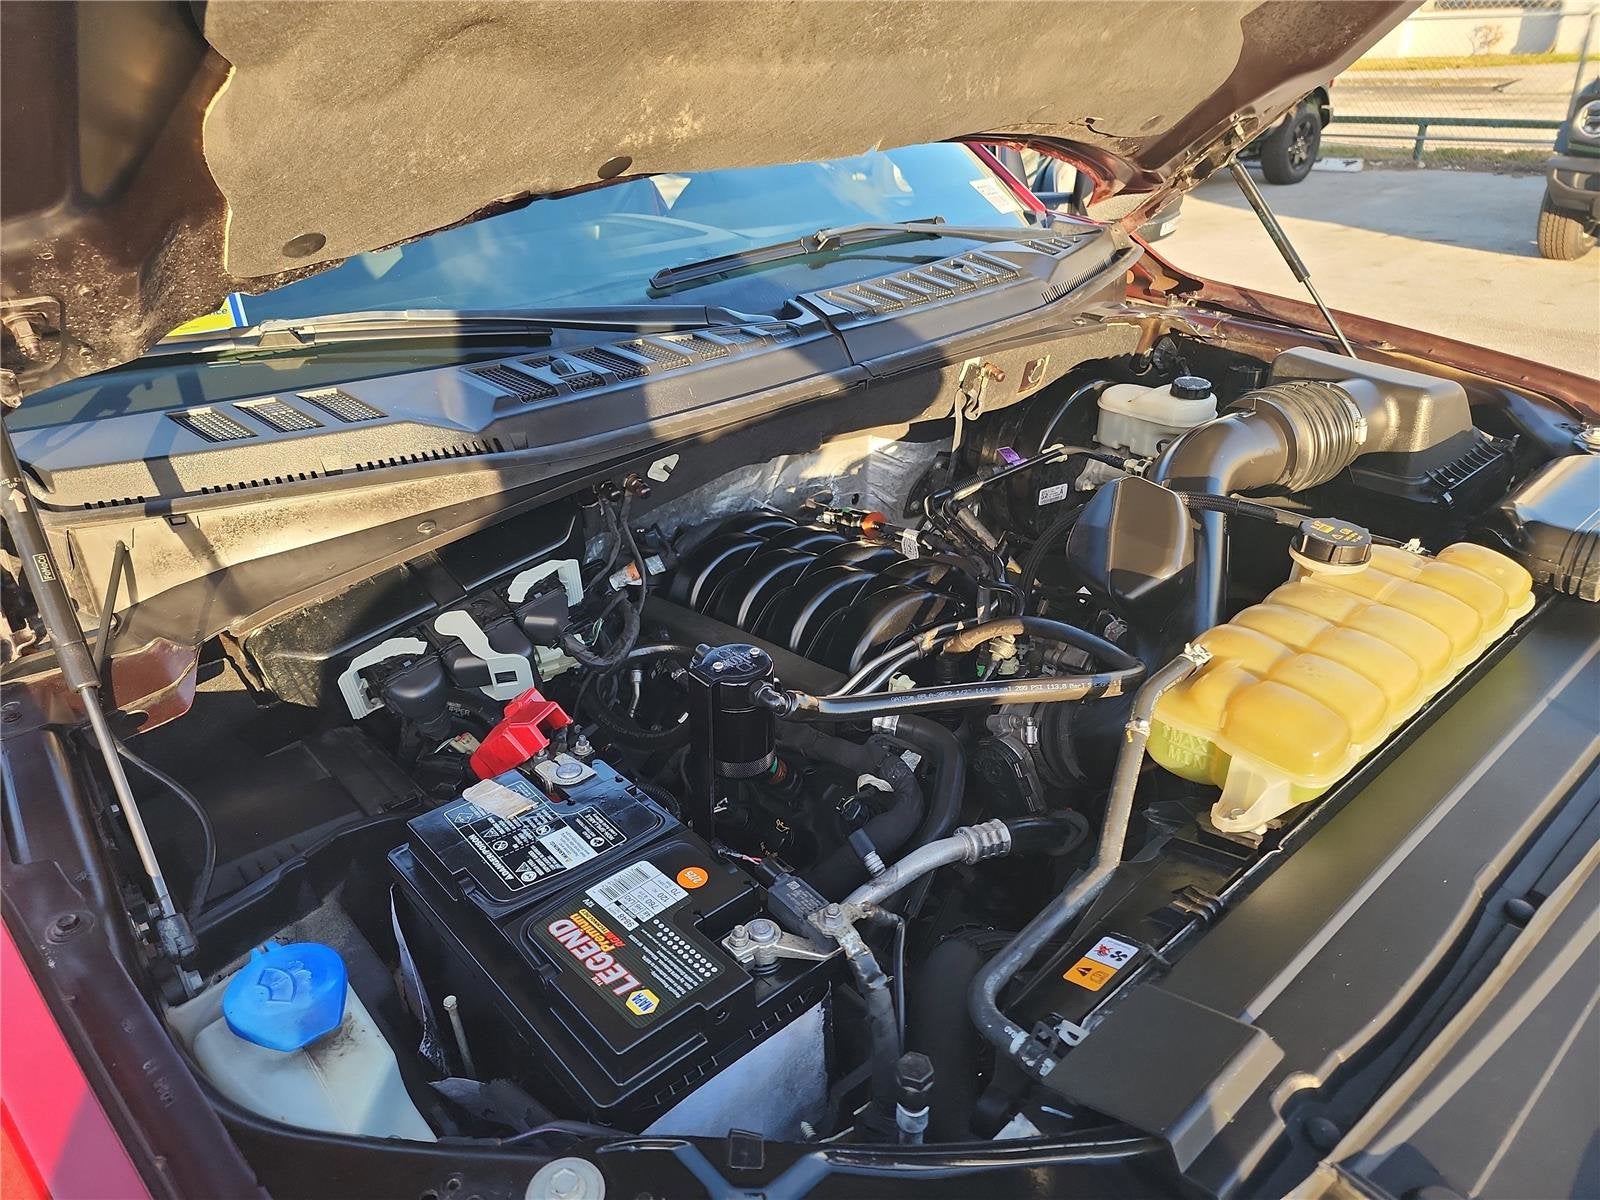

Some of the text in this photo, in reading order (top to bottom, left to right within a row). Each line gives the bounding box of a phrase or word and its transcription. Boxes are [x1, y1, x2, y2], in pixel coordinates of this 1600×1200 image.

[1014, 684, 1028, 692] 200
[1168, 728, 1210, 754] MAX
[1167, 744, 1208, 770] MIN
[467, 833, 511, 877] DANGER/POISON
[656, 892, 670, 902] 120
[669, 887, 681, 896] 70
[581, 897, 596, 908] 12V
[644, 898, 659, 909] 760
[616, 912, 634, 927] 9848
[569, 912, 617, 953] Premium
[548, 919, 641, 996] LEGEND
[590, 975, 604, 986] THE
[630, 992, 654, 1013] NAPA
